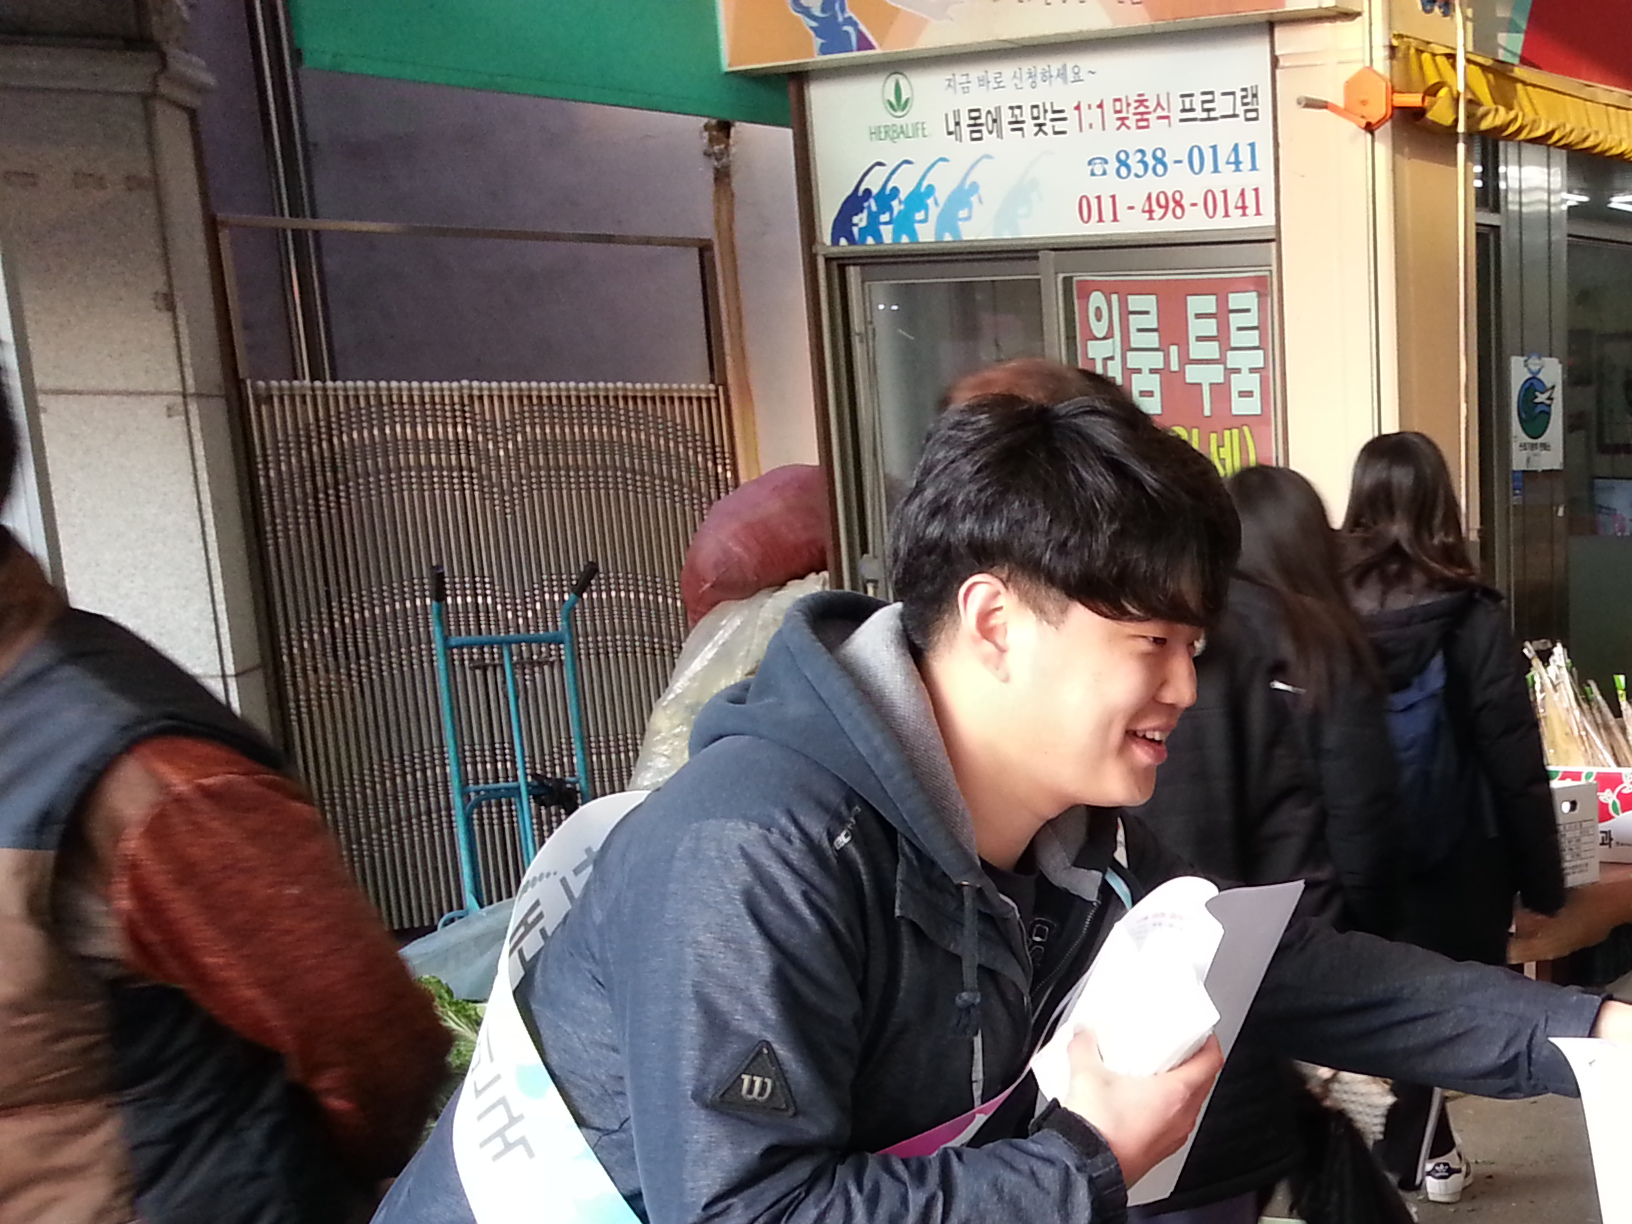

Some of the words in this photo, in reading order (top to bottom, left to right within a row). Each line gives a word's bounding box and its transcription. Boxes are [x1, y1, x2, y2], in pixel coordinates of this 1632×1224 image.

[945, 73, 972, 94] 지금
[977, 70, 1006, 92] 바로
[1073, 98, 1106, 133] 1:1
[1112, 91, 1172, 131] 맞춤식
[1178, 84, 1260, 124] 프로그램
[869, 121, 928, 144] HERBALIFE
[1114, 141, 1260, 181] 838-0141
[1078, 186, 1263, 225] 011-498-0141
